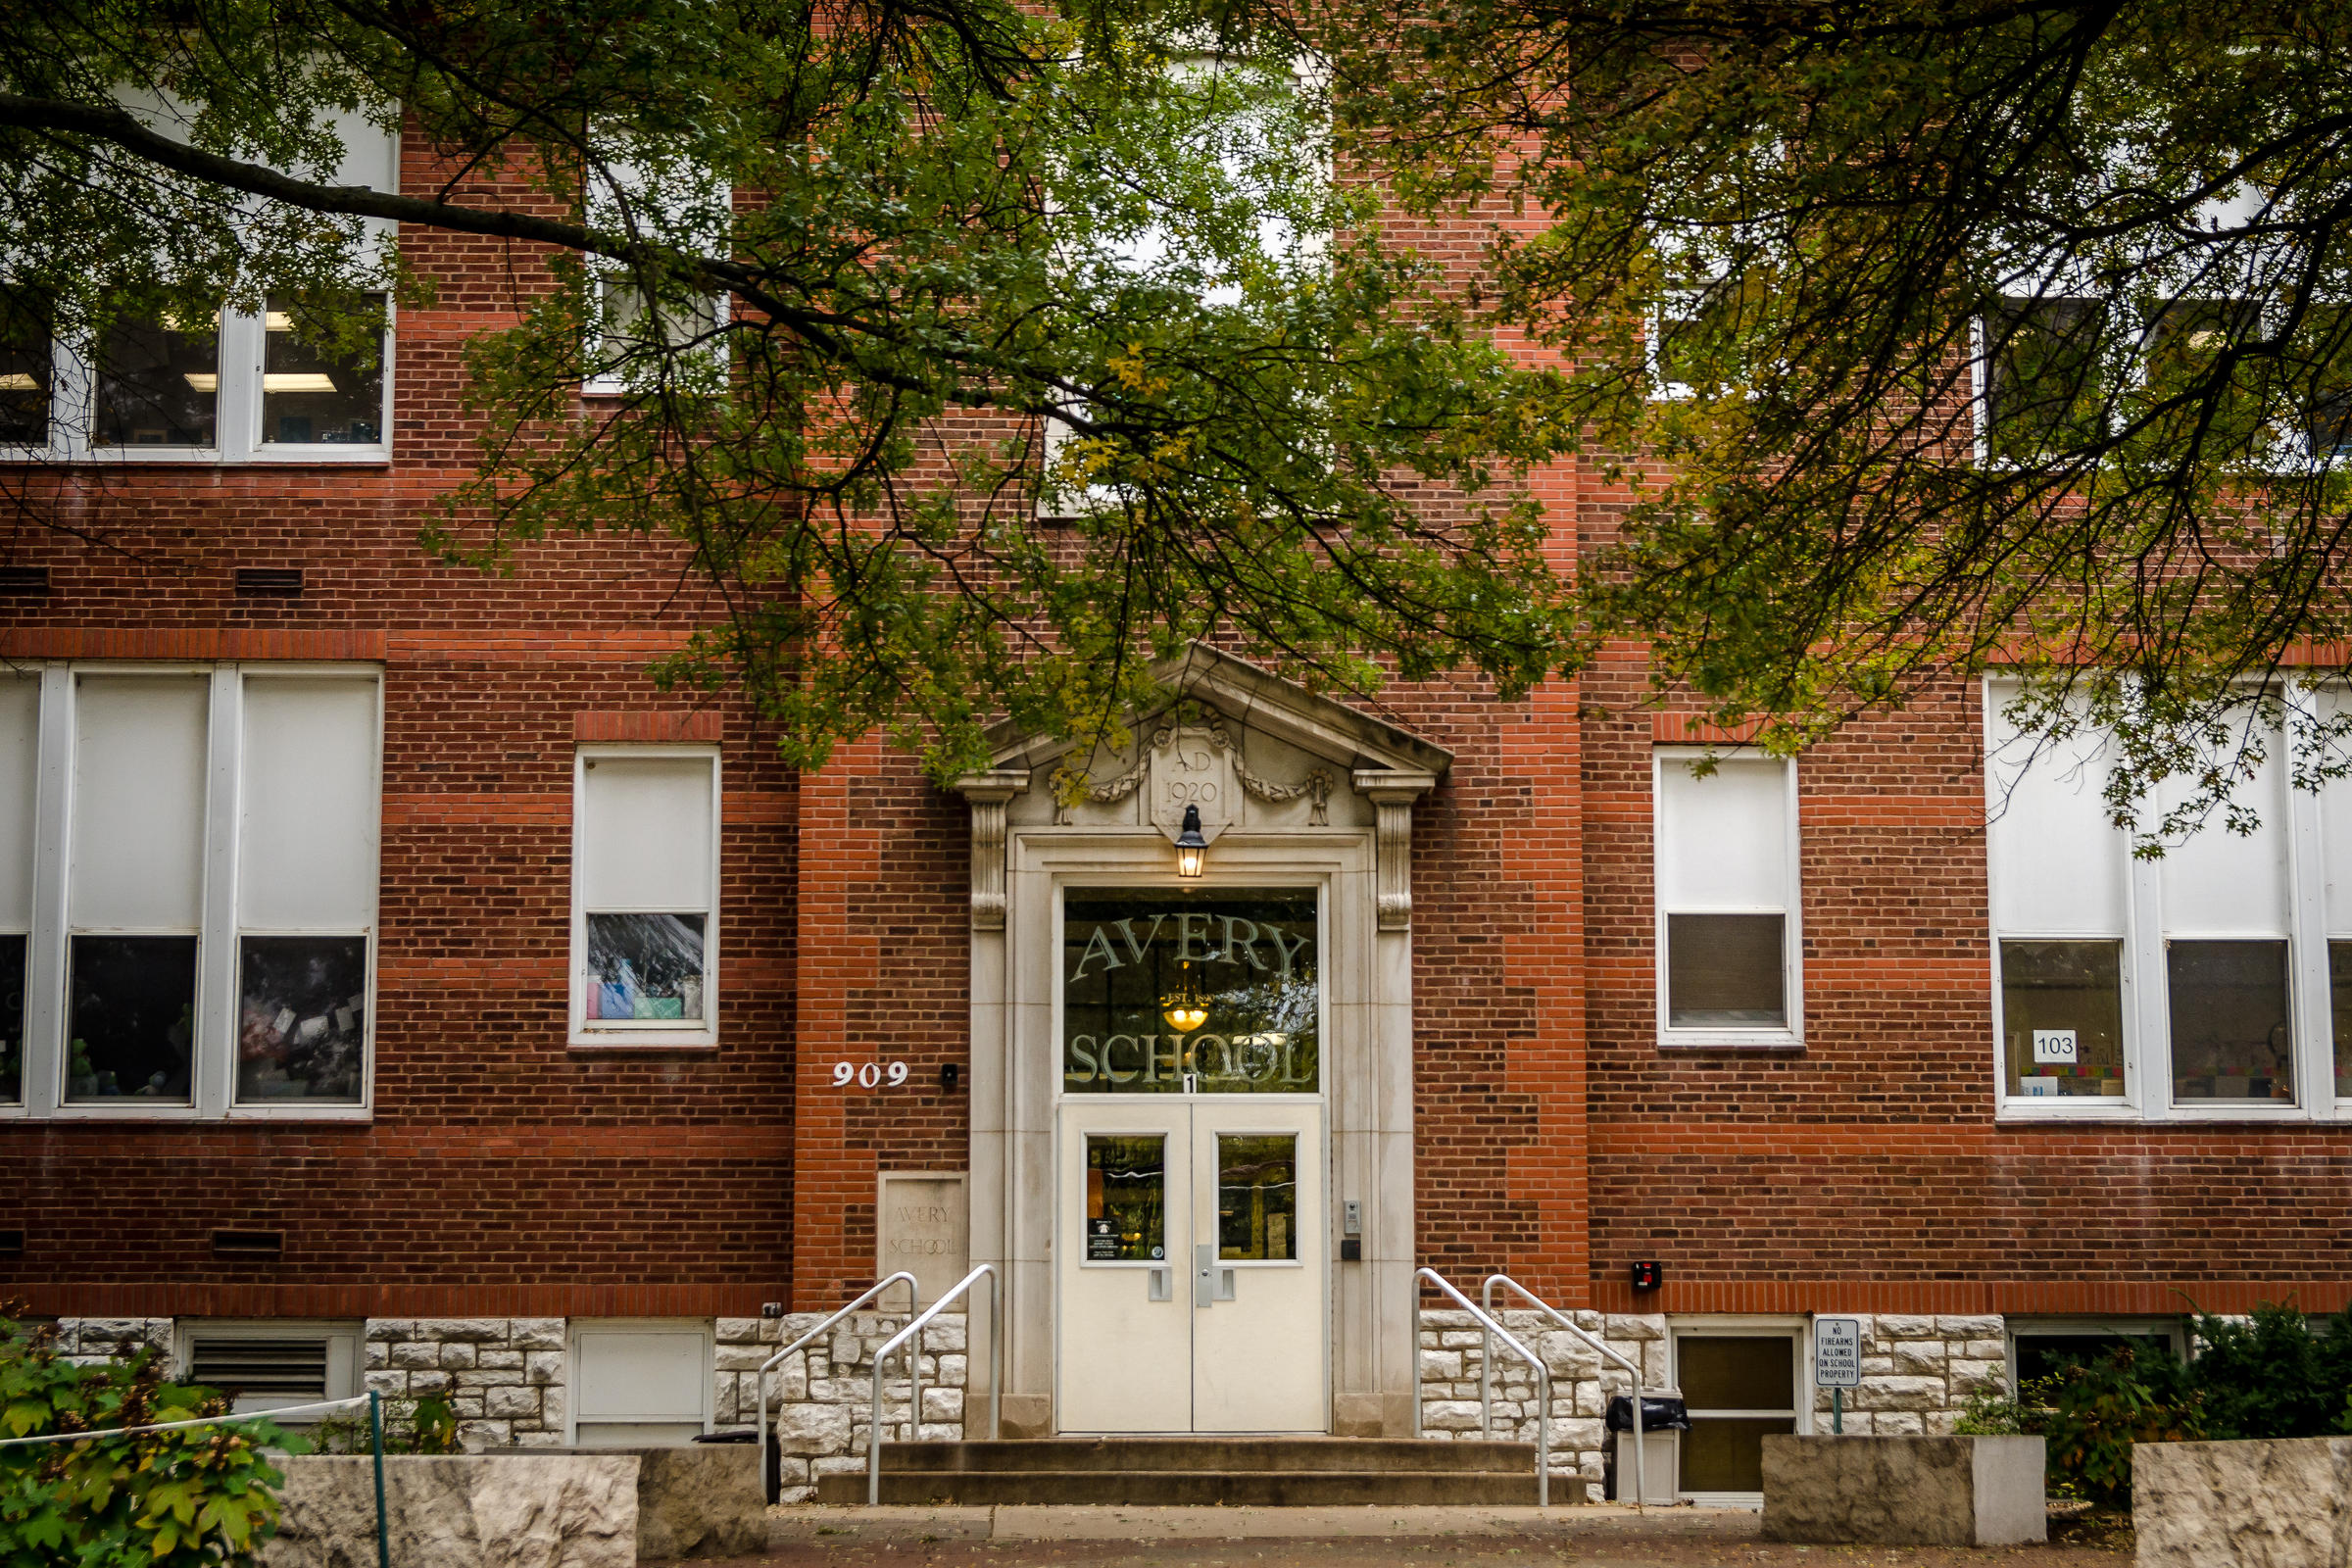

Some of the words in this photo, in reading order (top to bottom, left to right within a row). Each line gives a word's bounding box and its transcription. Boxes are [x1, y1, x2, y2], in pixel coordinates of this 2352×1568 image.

[1166, 782, 1217, 808] 1920
[1069, 912, 1311, 983] AVERY
[2038, 1037, 2073, 1054] 103
[1070, 1034, 1313, 1083] SCHOOL
[832, 1061, 908, 1089] 909
[1187, 1074, 1194, 1094] 1
[896, 1206, 950, 1223] AVERY
[888, 1239, 957, 1255] SCHOOL
[1821, 1337, 1853, 1346] FIREARMS
[1823, 1348, 1852, 1357] ALLOWED
